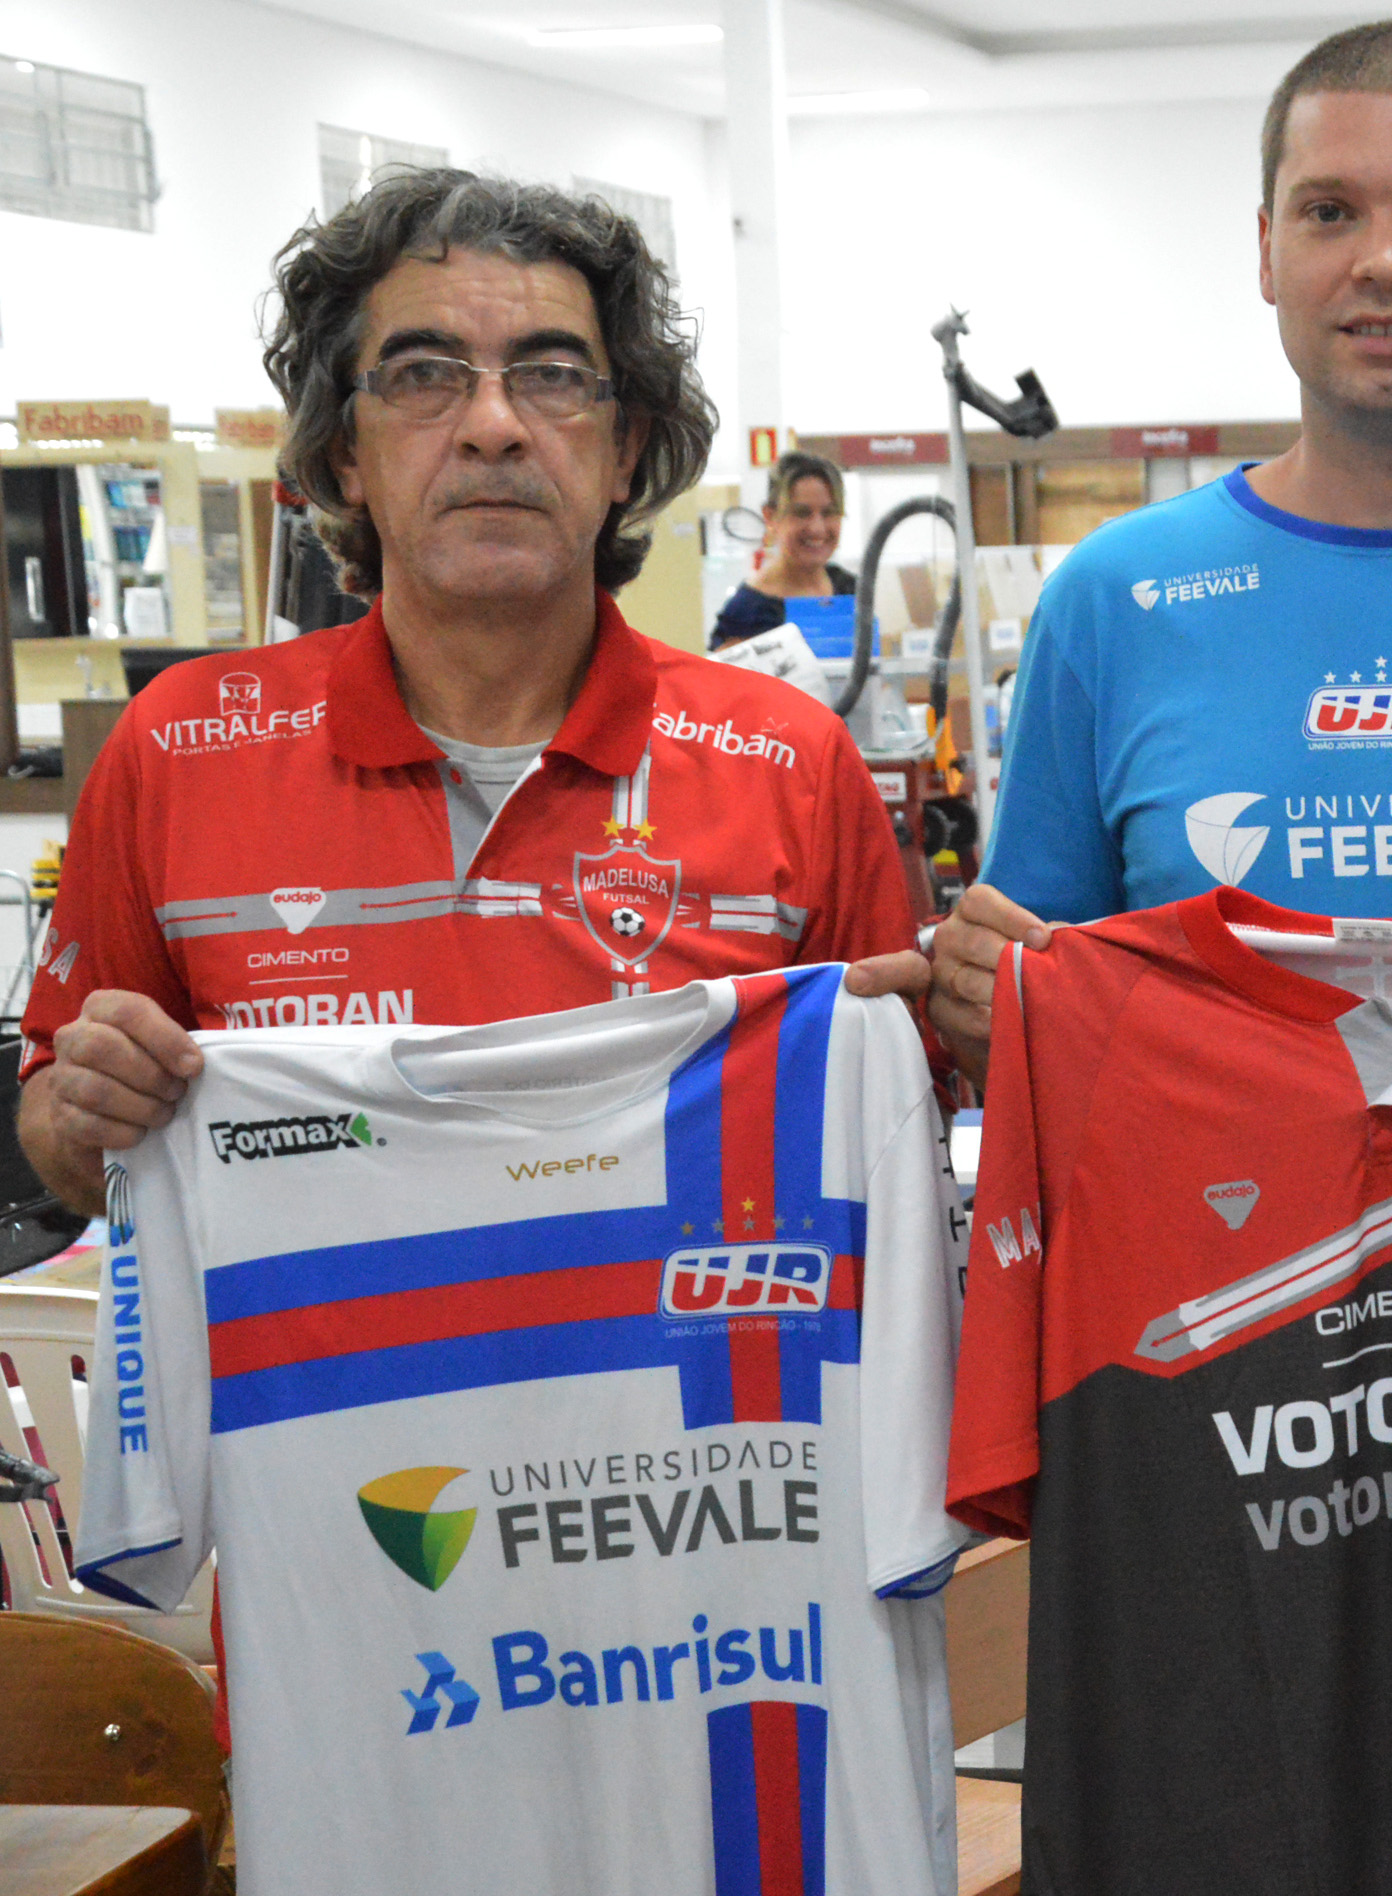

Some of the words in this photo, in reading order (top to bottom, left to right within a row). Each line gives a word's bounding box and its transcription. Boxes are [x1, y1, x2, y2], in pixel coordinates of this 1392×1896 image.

[1164, 563, 1259, 587] UNIVERSIDADE
[1165, 573, 1260, 605] FEEVALE
[173, 742, 231, 756] PORTAS
[245, 729, 312, 745] JANELAS
[1336, 741, 1364, 750] JOVEM
[1366, 741, 1378, 749] DO
[583, 868, 669, 898] MADELUSA
[603, 893, 649, 905] FUTSAL
[248, 947, 349, 968] CIMENTO
[208, 1113, 361, 1164] Formax
[672, 1253, 821, 1311] UJR
[700, 1323, 736, 1335] JOVEM
[738, 1322, 754, 1332] DO
[111, 1255, 148, 1455] UNIQUE
[490, 1440, 817, 1496] UNIVERSIDADE
[497, 1479, 820, 1568] FEEVALE
[491, 1602, 823, 1711] Banrisul
